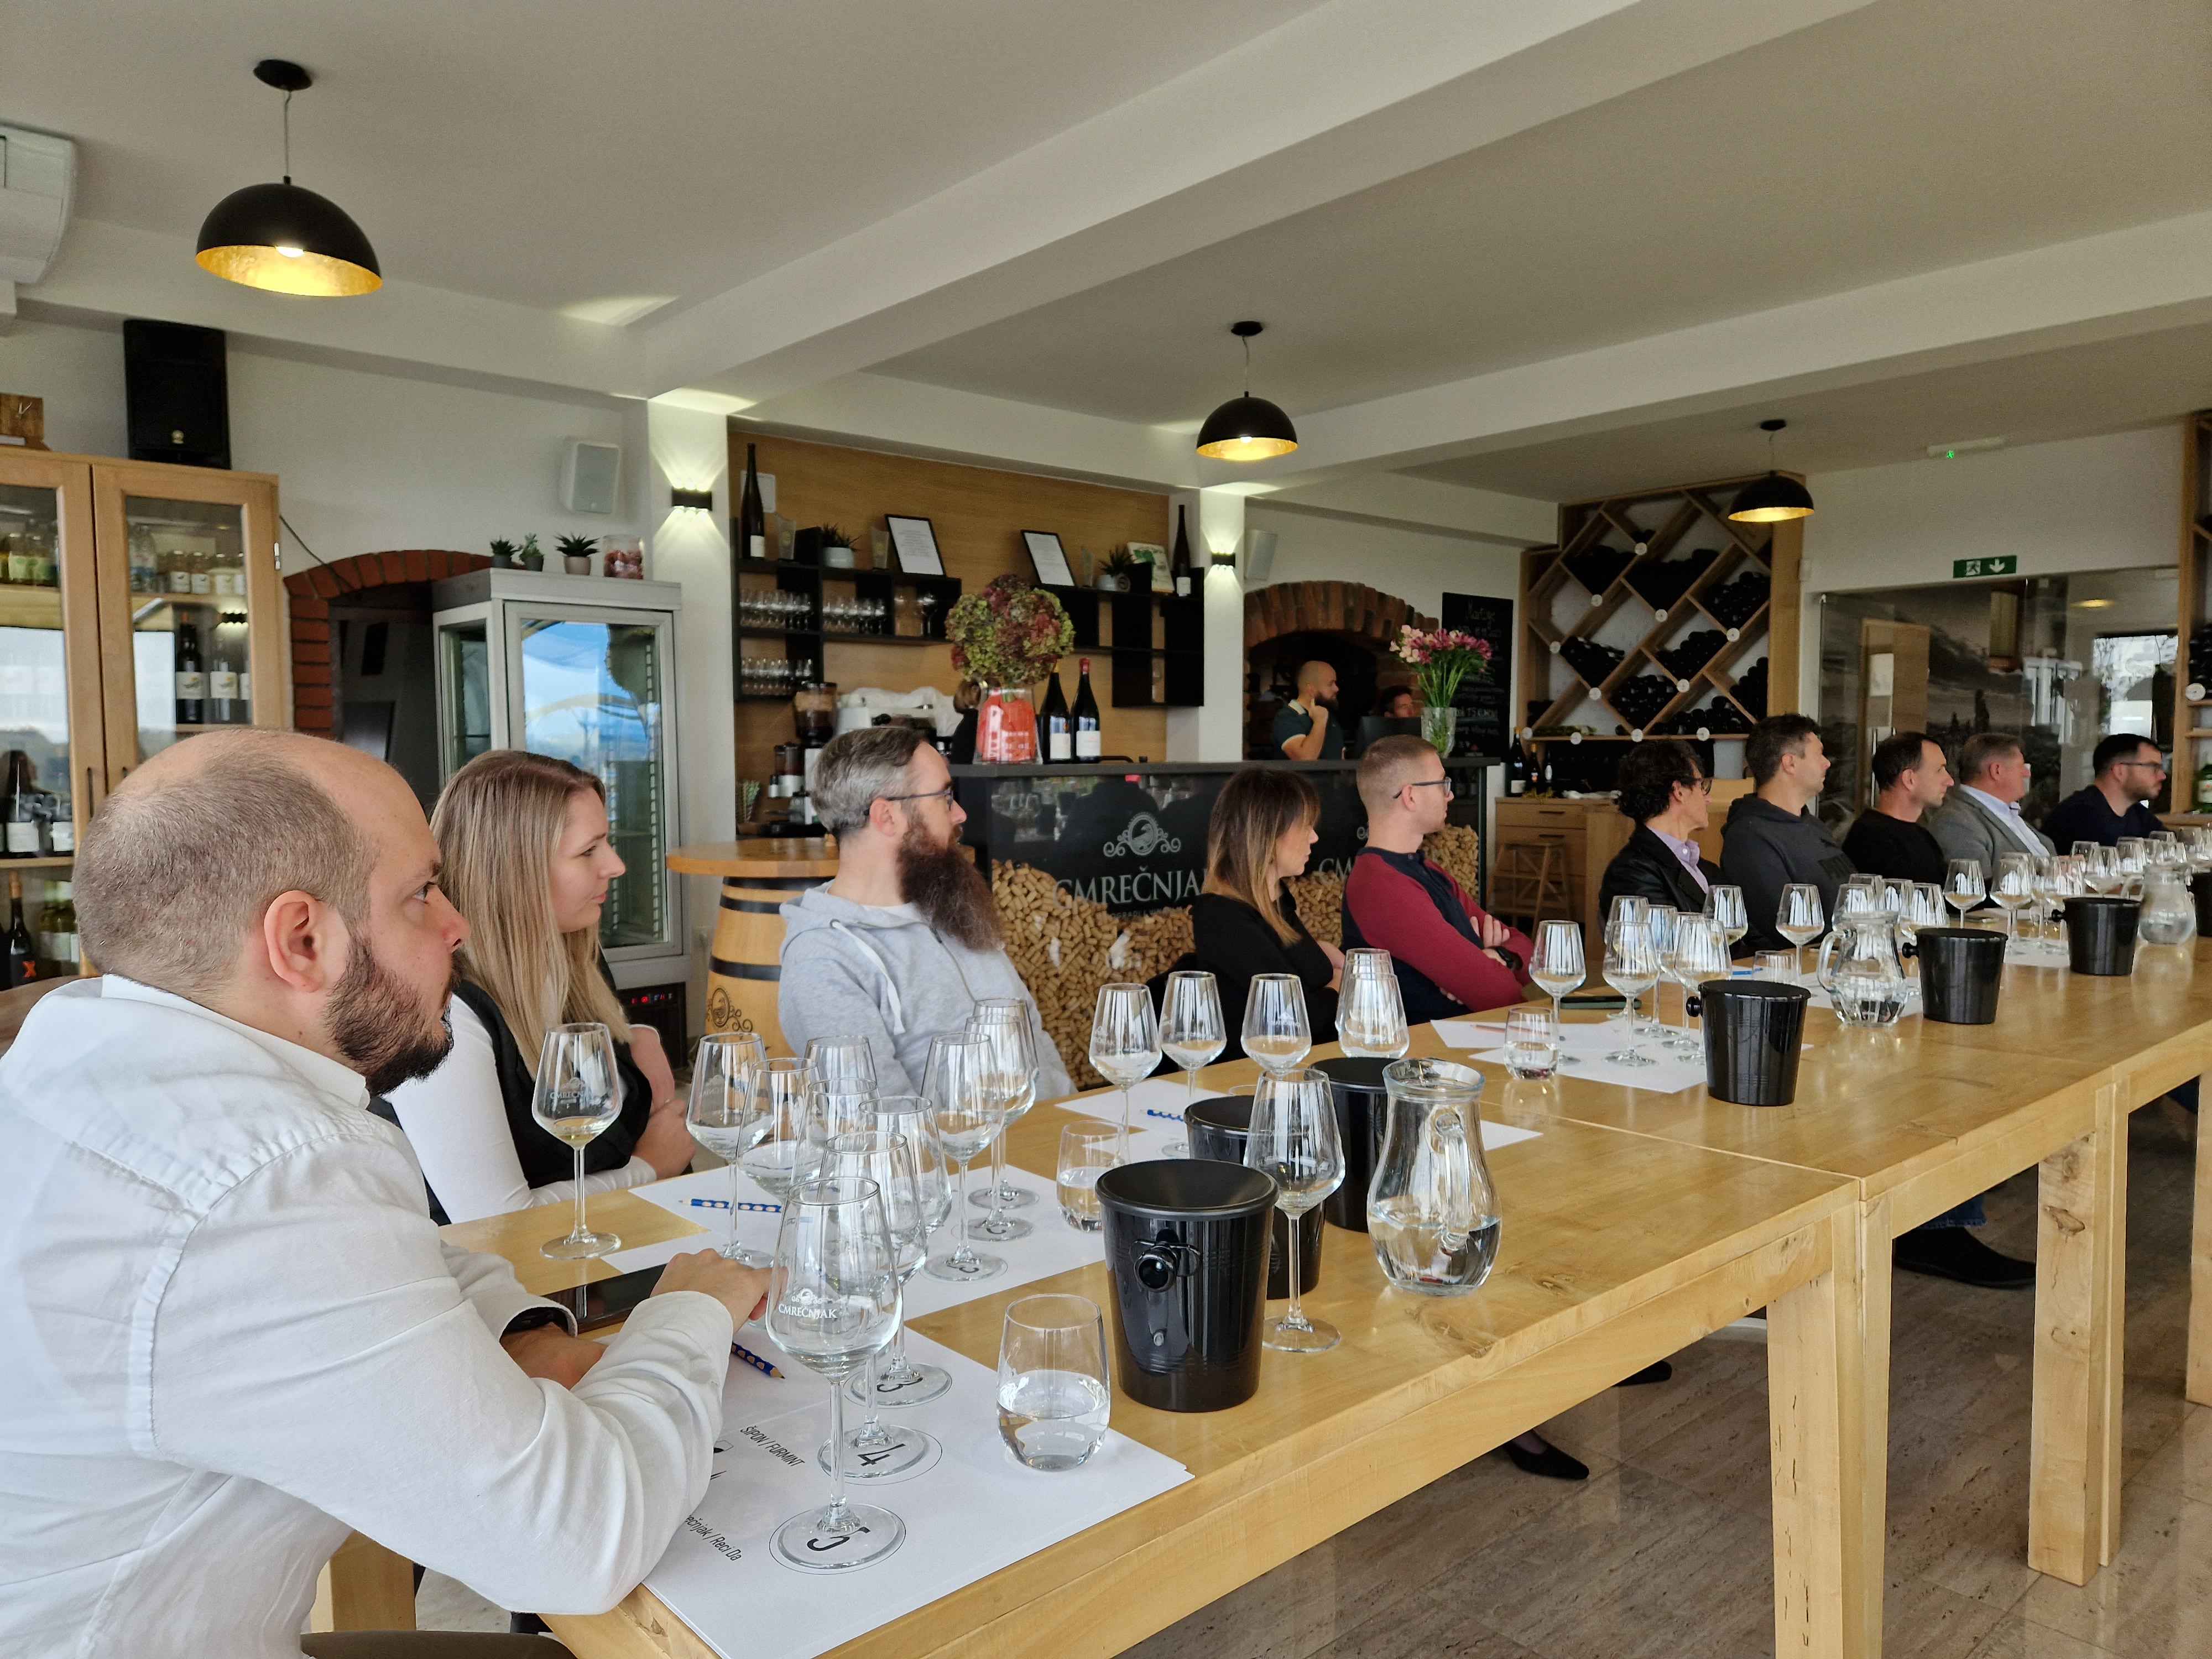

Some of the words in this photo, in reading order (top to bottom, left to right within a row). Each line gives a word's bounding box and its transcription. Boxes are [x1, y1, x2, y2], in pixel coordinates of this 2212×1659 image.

[1052, 864, 1208, 910] CMREČNJA
[740, 1425, 770, 1443] ŠIPON
[765, 1443, 806, 1467] FURMINT
[856, 1443, 906, 1466] 4
[685, 1515, 713, 1537] ečnjak
[709, 1536, 735, 1553] Reci
[725, 1549, 742, 1561] Da
[806, 1526, 871, 1552] 5
